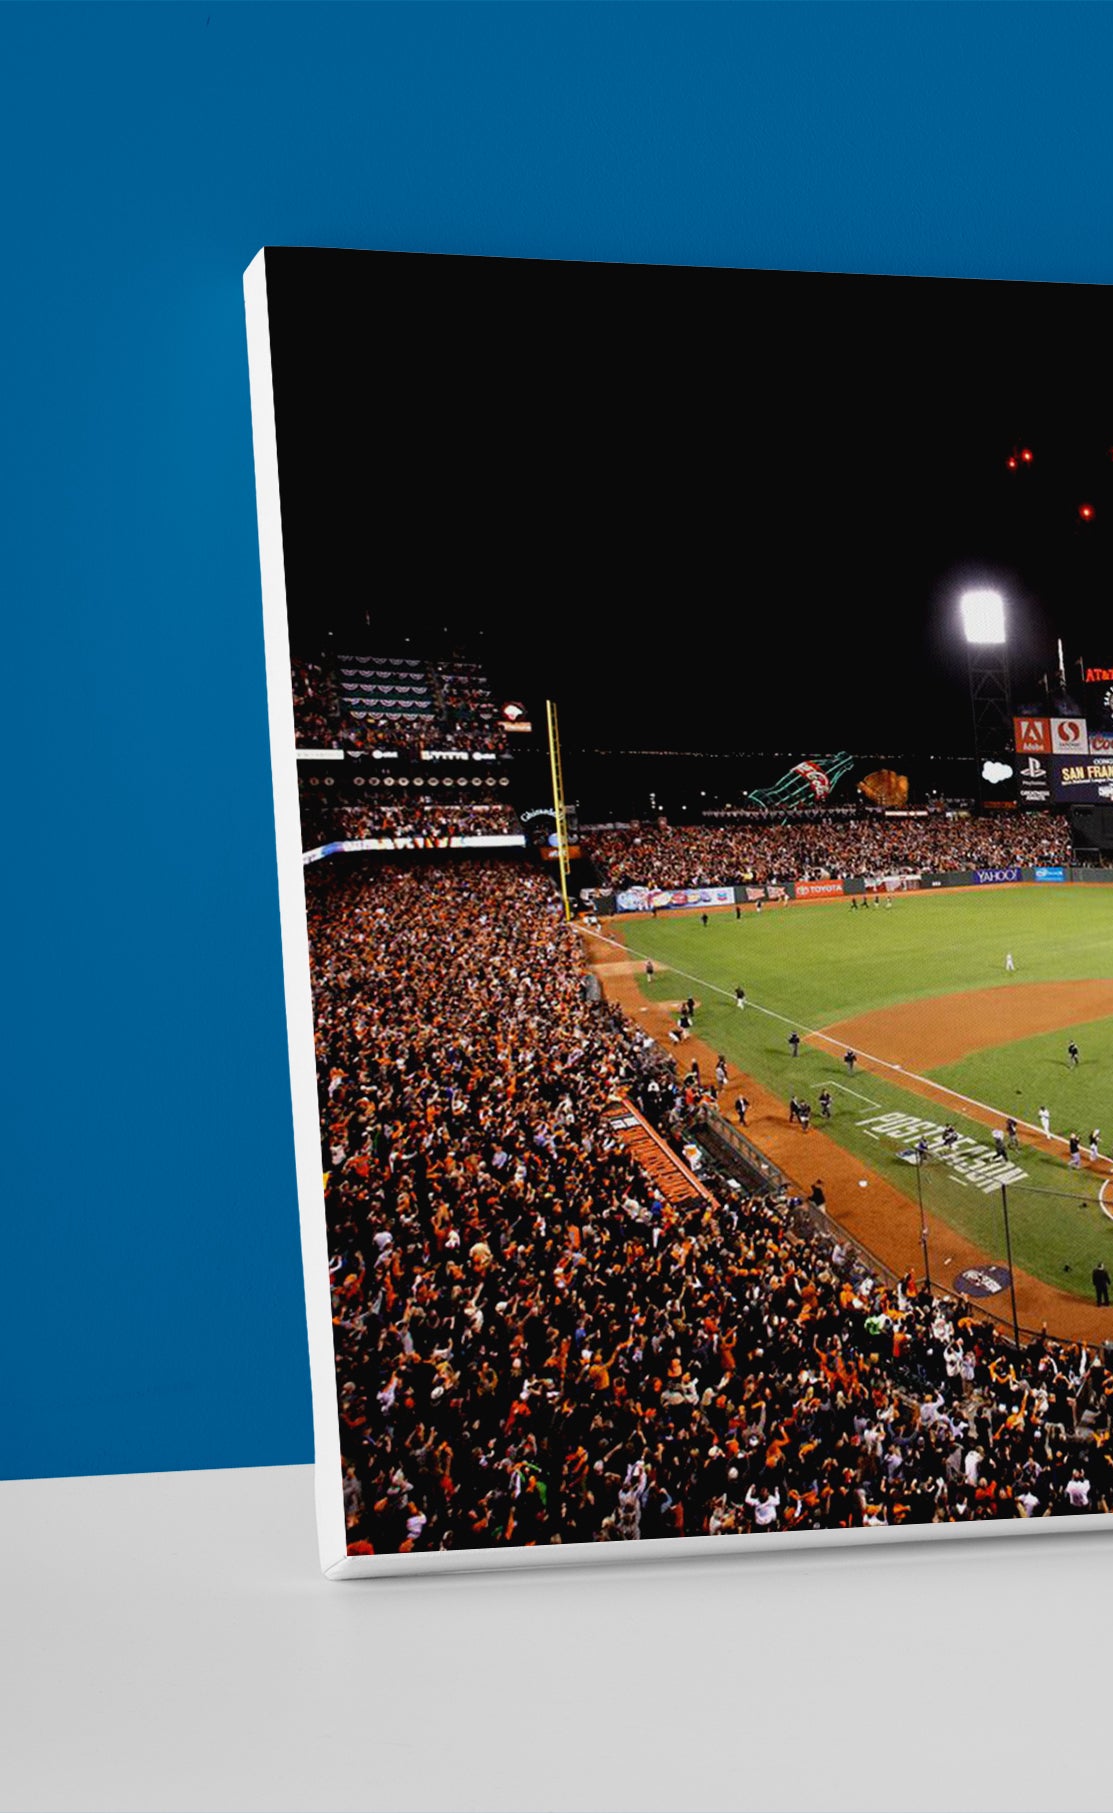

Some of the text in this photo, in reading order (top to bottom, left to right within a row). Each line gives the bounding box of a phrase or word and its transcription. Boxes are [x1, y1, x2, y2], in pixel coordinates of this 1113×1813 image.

[1061, 766, 1085, 781] SAN
[976, 868, 1018, 884] YAHOO!
[809, 883, 843, 893] TOYOTA
